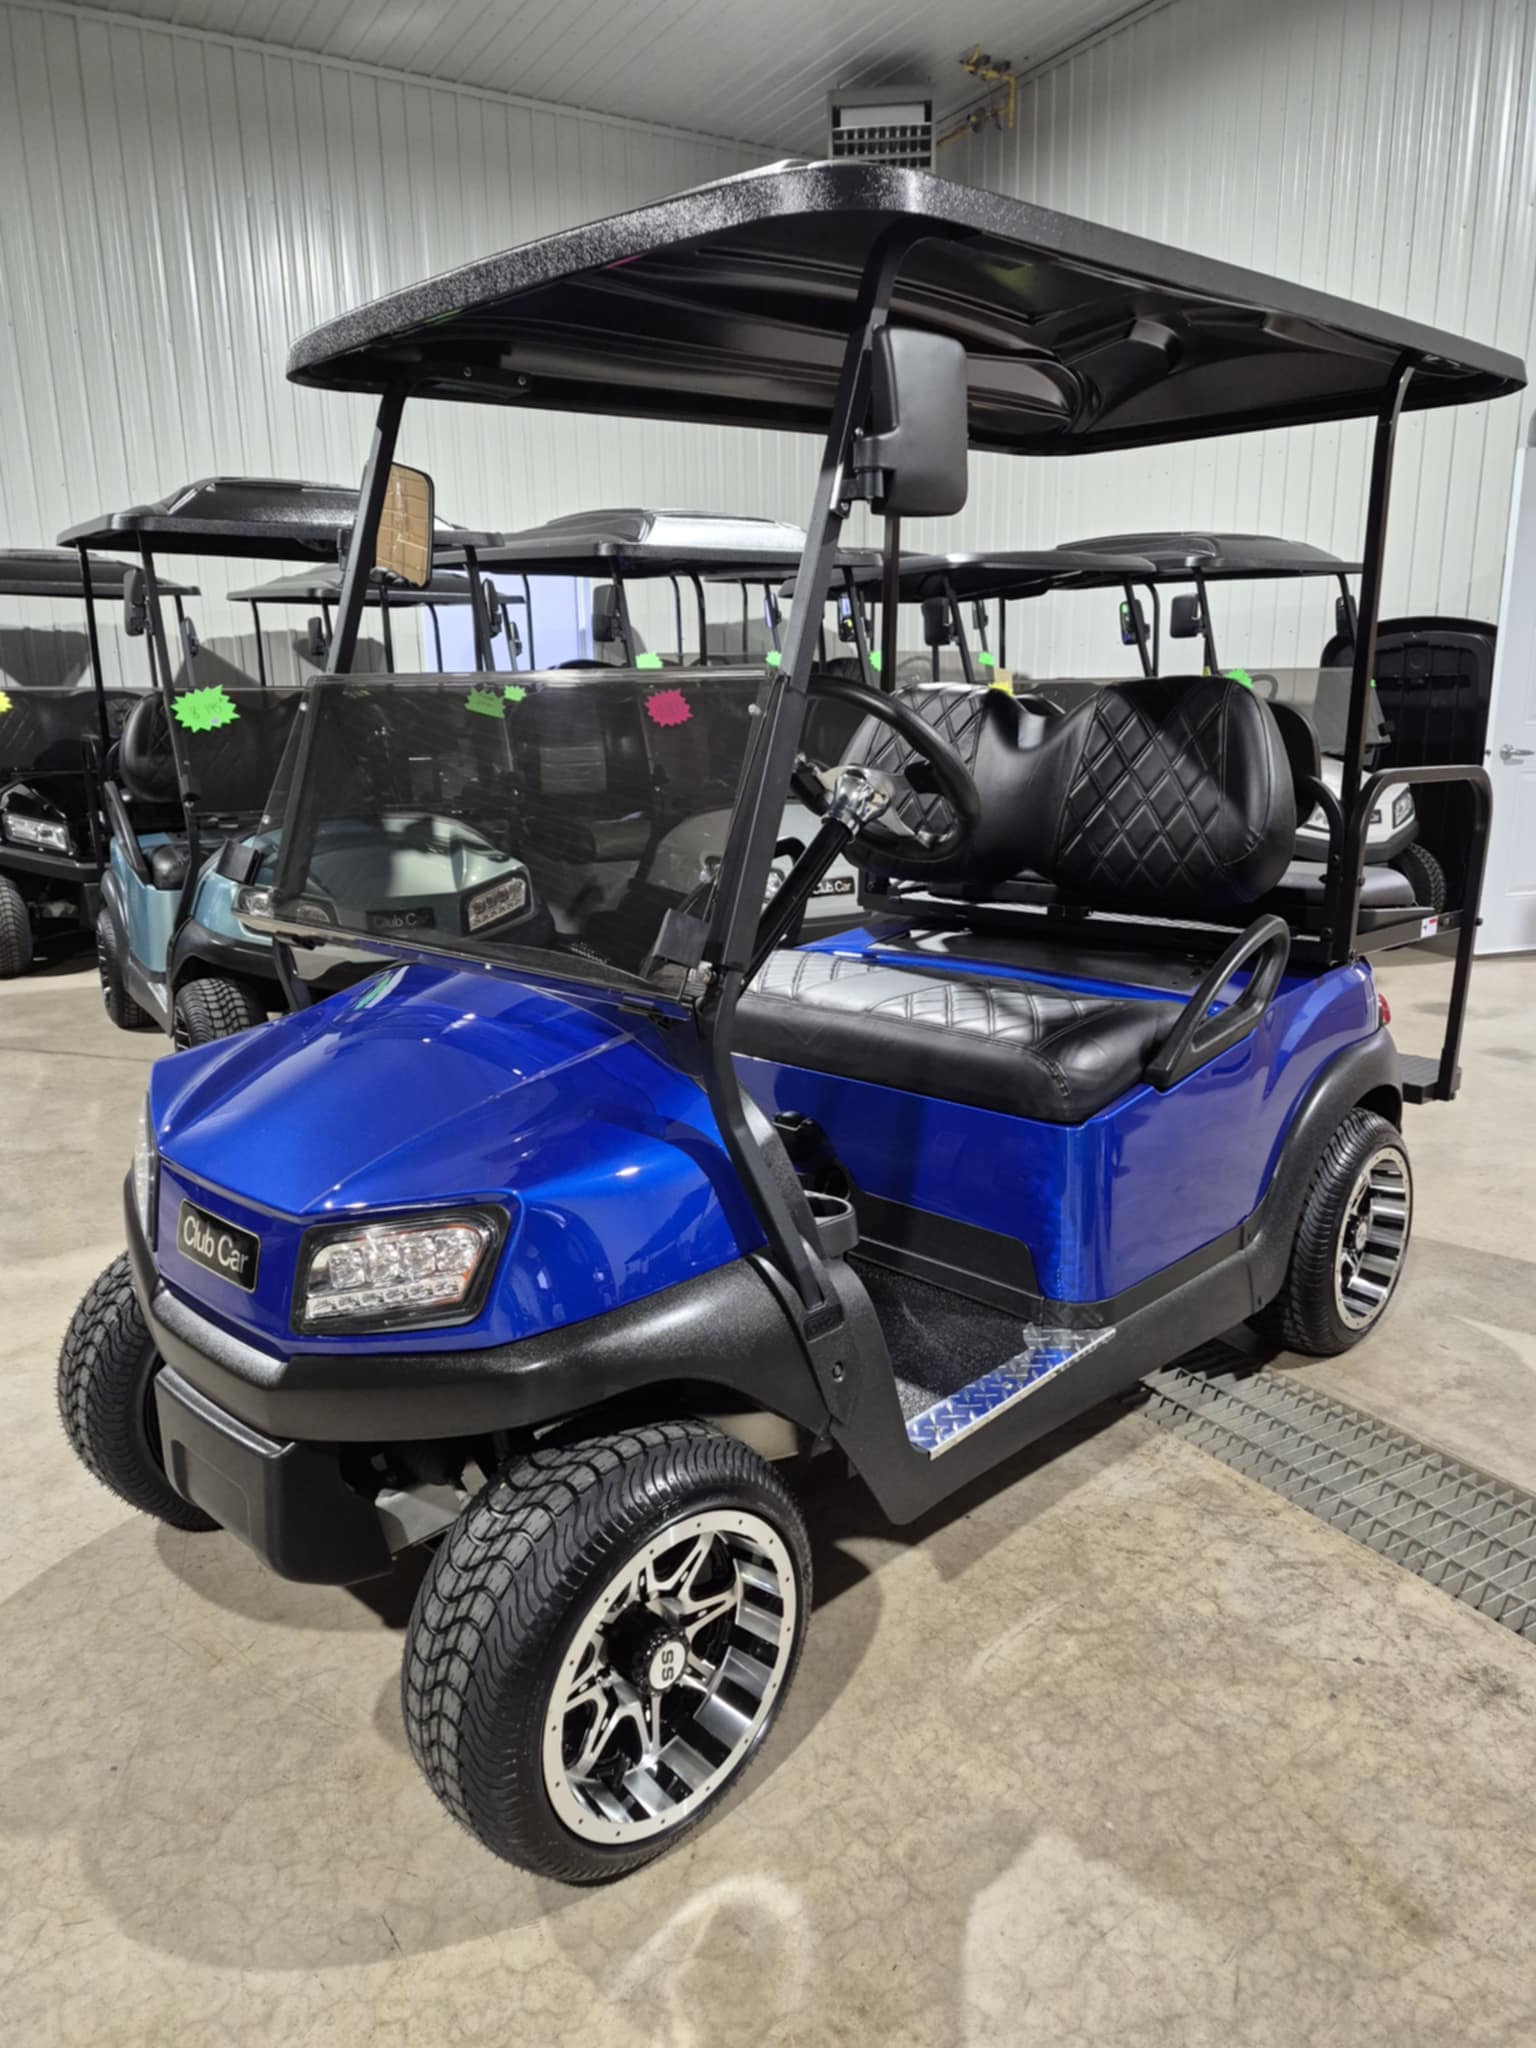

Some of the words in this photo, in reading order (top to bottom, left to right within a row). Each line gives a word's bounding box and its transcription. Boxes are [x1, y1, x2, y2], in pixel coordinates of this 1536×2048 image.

[183, 1215, 215, 1258] Club
[217, 1235, 250, 1274] Car
[661, 1650, 674, 1682] SS
